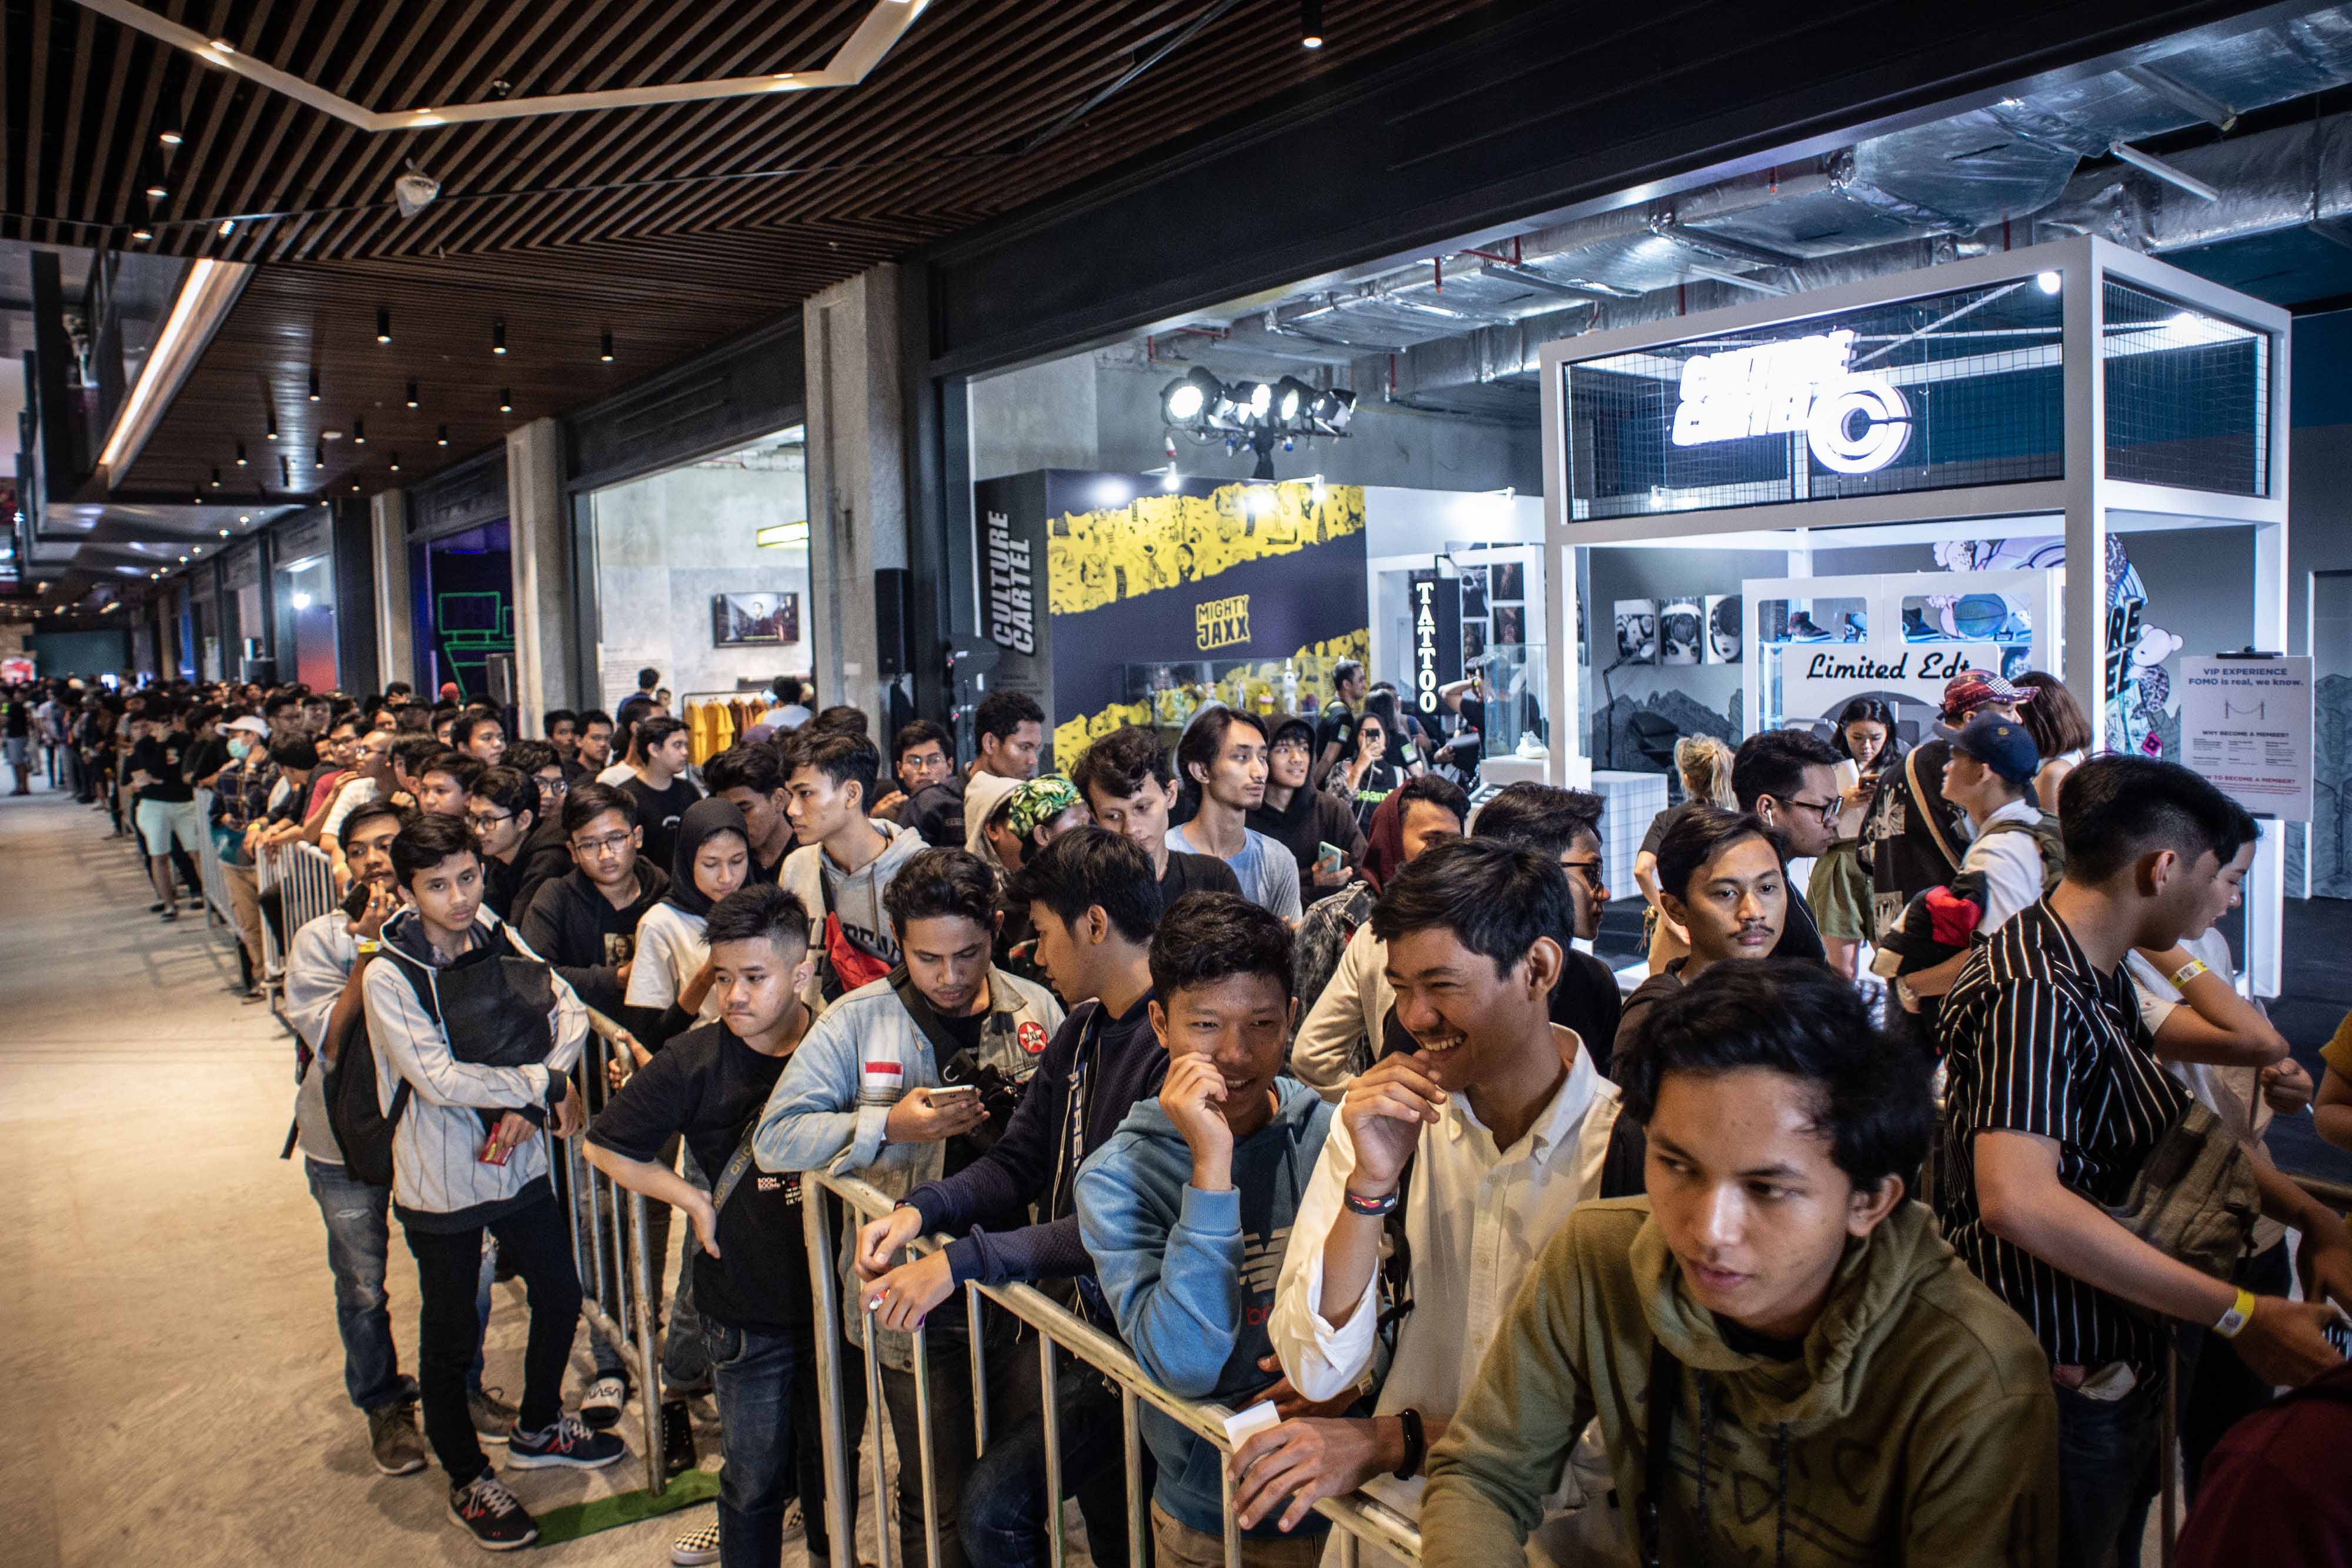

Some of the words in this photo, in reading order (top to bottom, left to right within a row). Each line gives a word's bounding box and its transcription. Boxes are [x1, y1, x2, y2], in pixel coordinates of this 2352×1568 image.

[987, 510, 1013, 647] CULTURE
[1009, 539, 1034, 654] CARTEL
[1198, 595, 1248, 623] MIGHTY
[1198, 616, 1248, 647] JAXX
[1416, 581, 1438, 714] TATTOO
[1806, 651, 1909, 680] Limited
[2231, 678, 2253, 686] real,
[2273, 678, 2304, 686] know.
